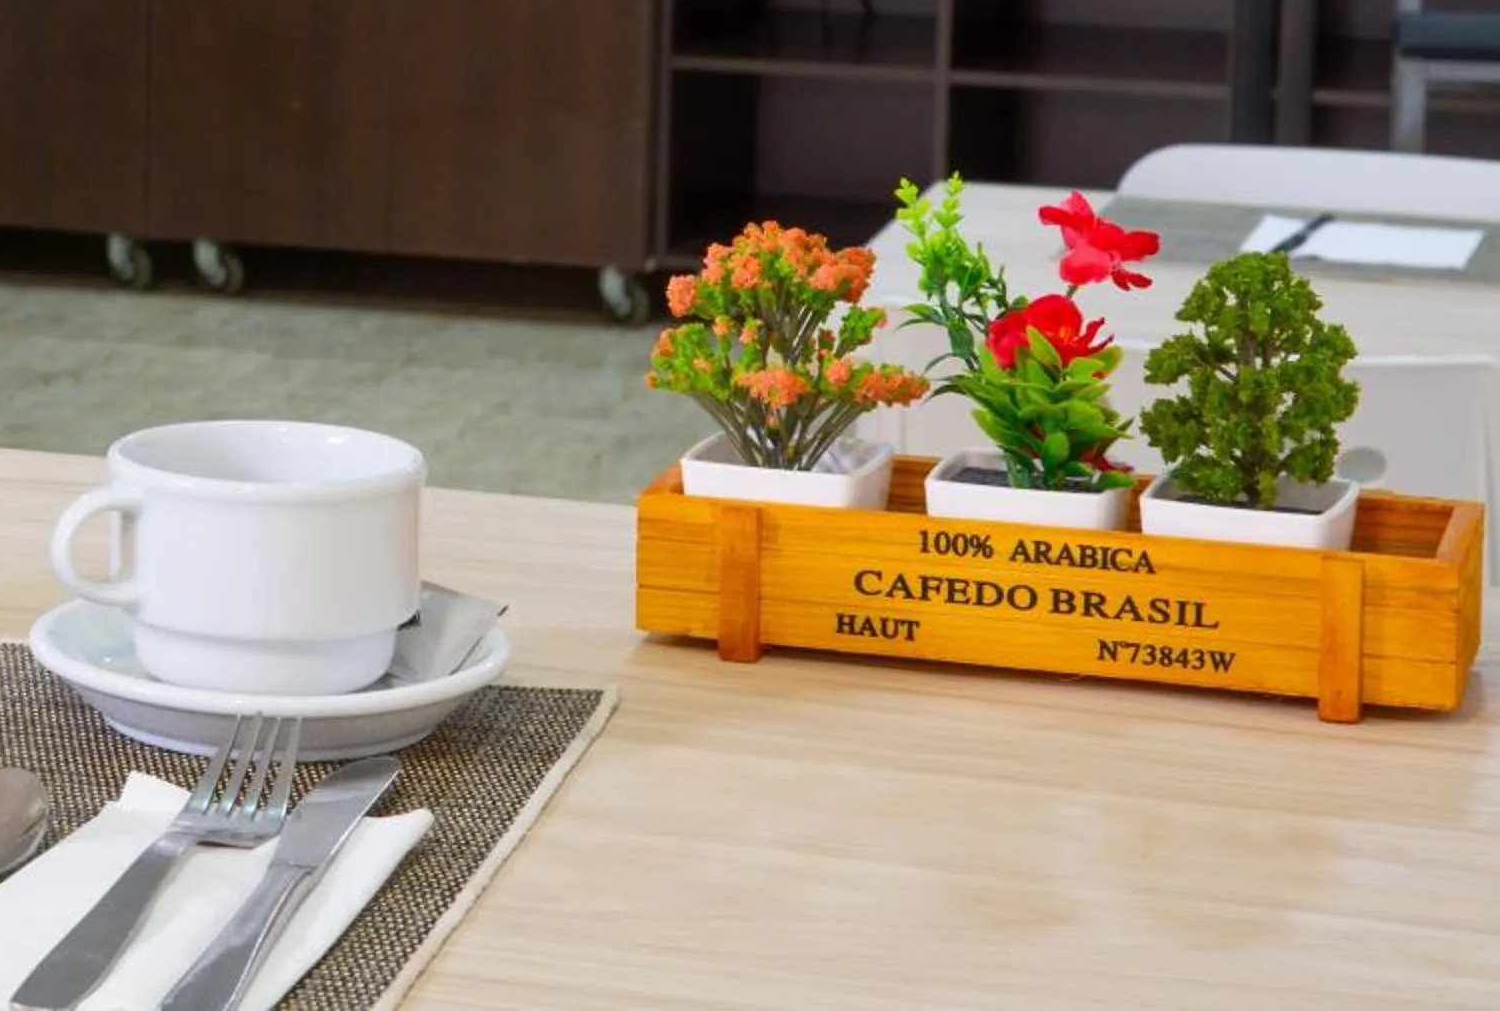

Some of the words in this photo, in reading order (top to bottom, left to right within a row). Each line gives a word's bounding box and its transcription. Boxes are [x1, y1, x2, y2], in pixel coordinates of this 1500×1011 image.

[919, 530, 994, 559] 100%
[1008, 539, 1156, 575] ARABICA
[853, 570, 1038, 611] CAFEDO
[1049, 588, 1219, 629] BRASIL
[835, 612, 921, 642] HAUT
